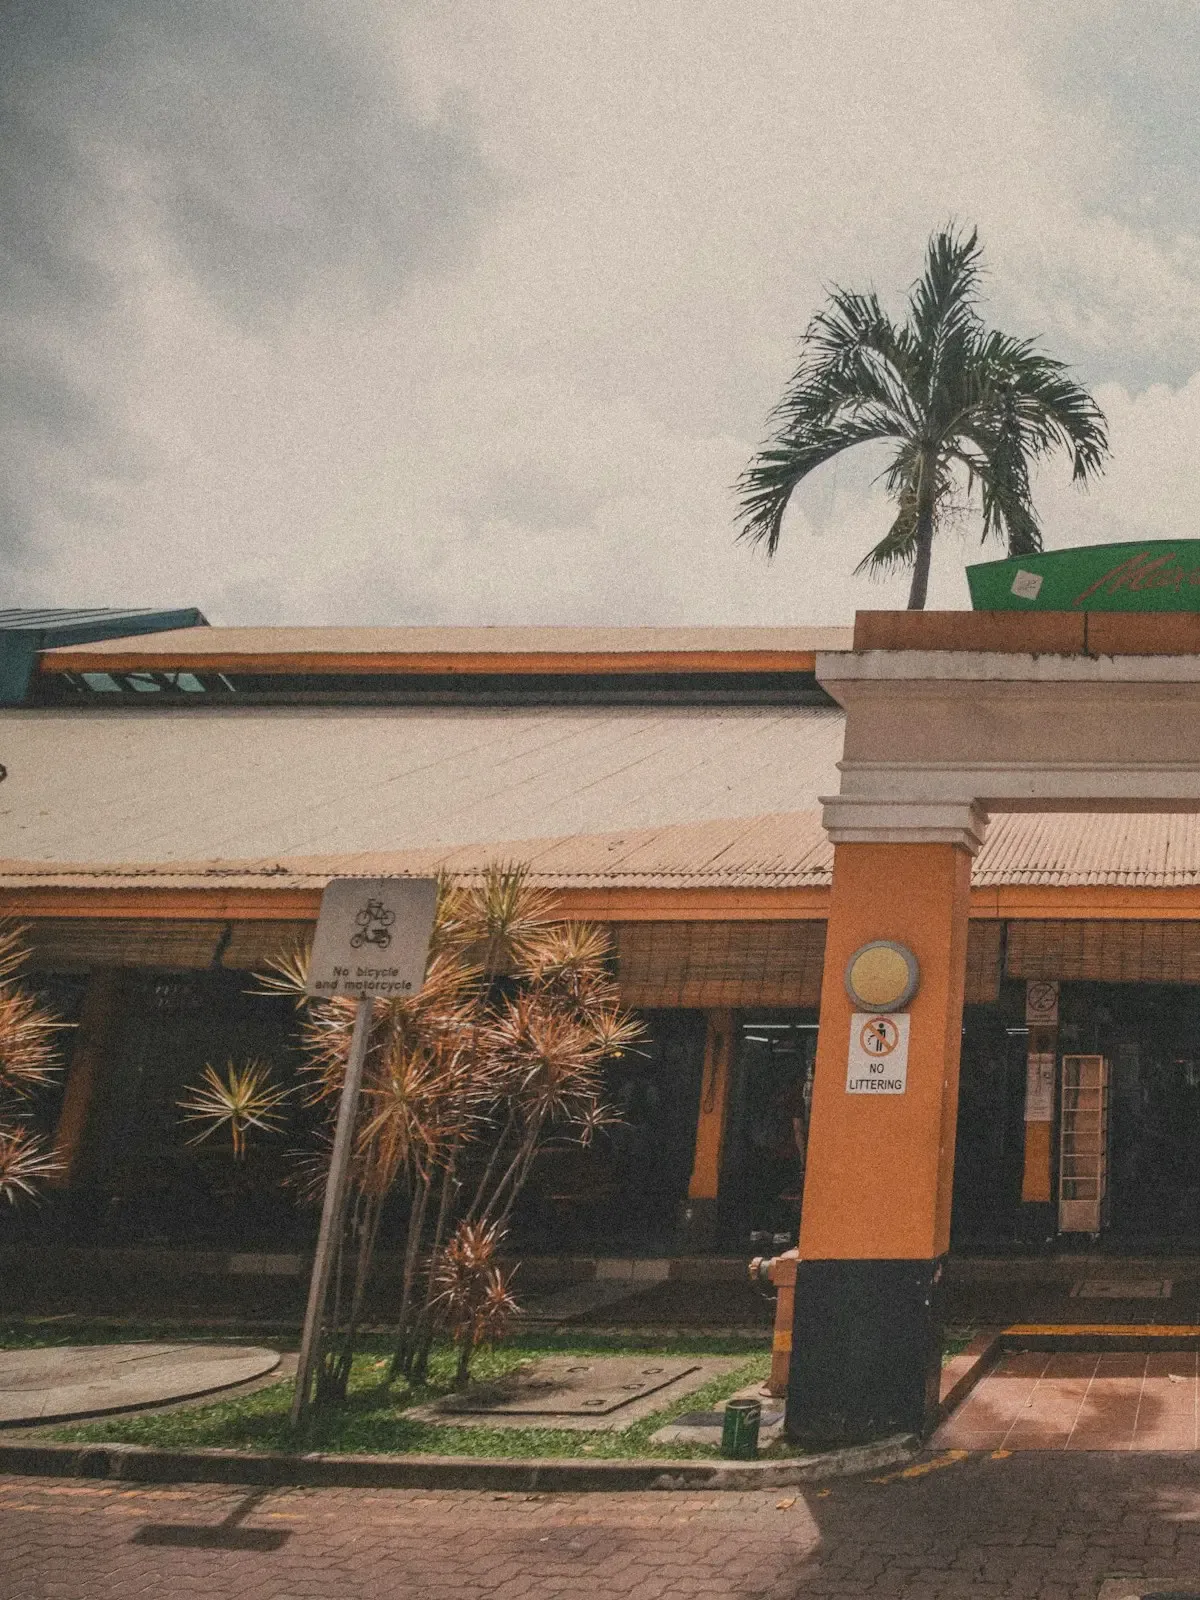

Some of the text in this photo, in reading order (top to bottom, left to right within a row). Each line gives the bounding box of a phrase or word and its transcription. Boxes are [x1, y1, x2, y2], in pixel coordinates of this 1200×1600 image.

[333, 967, 399, 979] No bicycle
[315, 980, 411, 991] and motorcycle
[869, 1064, 884, 1073] NO
[849, 1079, 902, 1090] LITTERING
